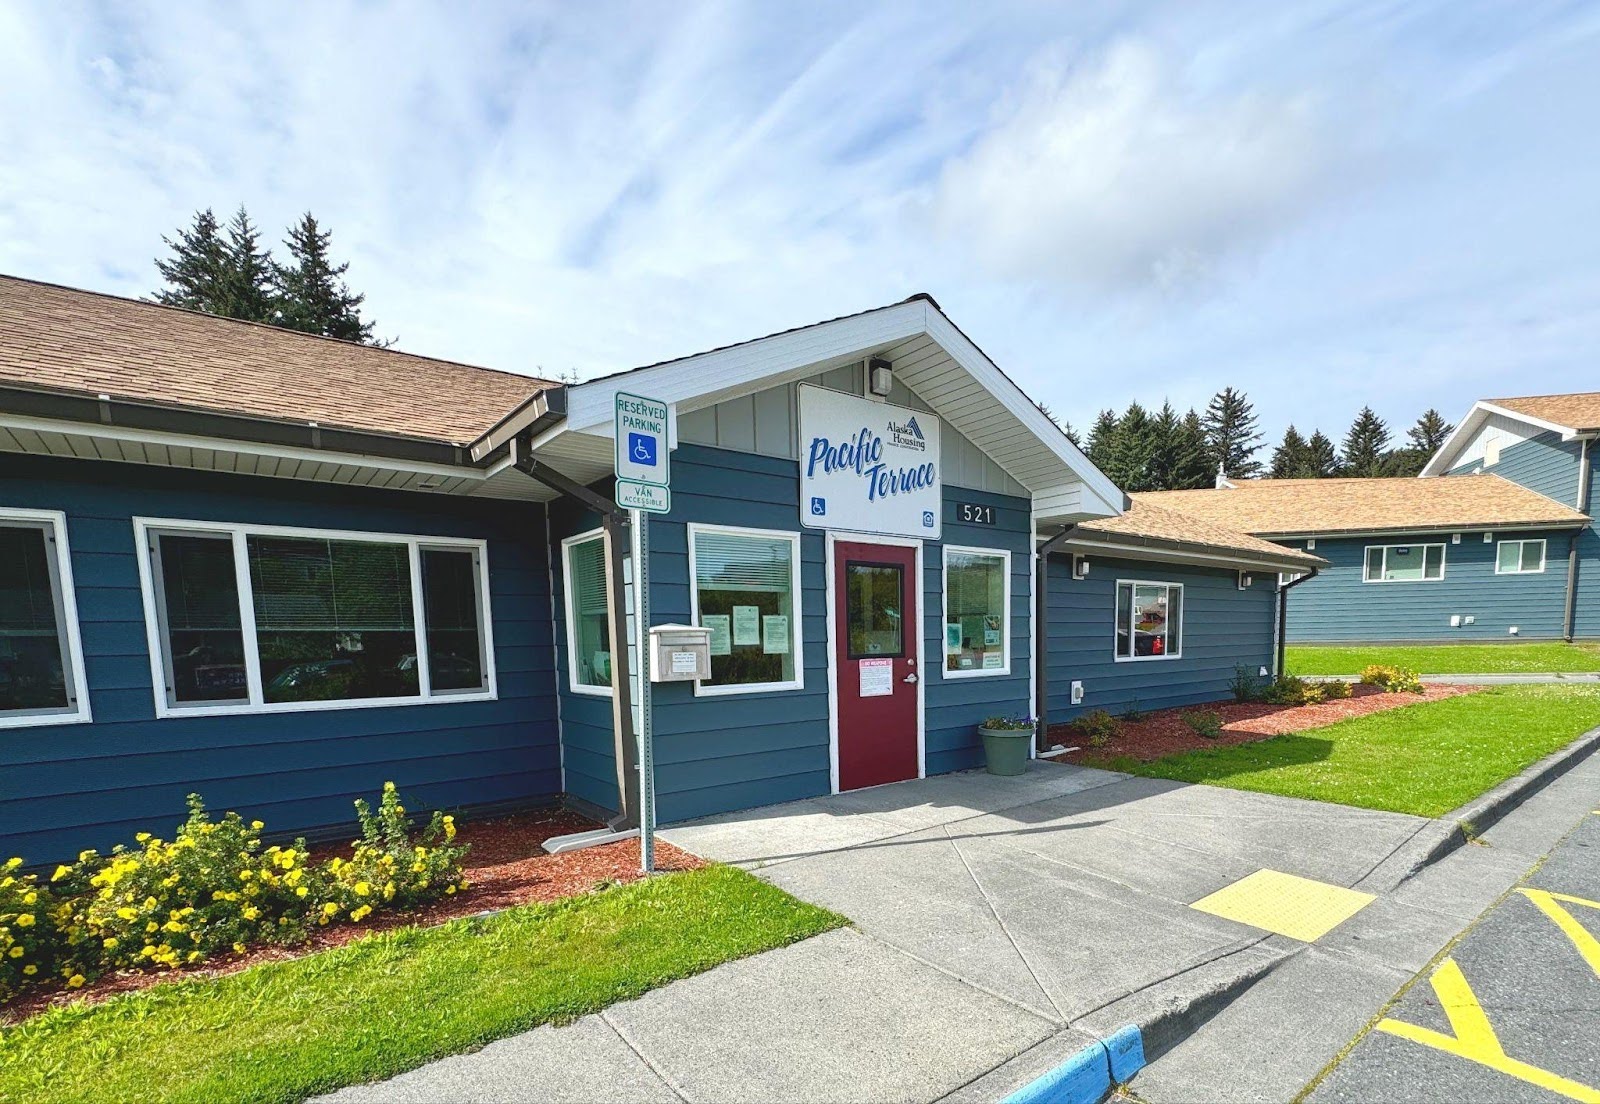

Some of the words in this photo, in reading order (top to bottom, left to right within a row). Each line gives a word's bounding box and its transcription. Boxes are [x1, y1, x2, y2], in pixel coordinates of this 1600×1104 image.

[618, 400, 666, 420] RESERVED
[623, 415, 661, 434] PARKING
[886, 421, 913, 436] Alaska
[893, 432, 925, 452] Housing
[807, 427, 882, 478] Pacific
[863, 462, 935, 502] Terrace
[624, 495, 663, 507] ACCESSIBLE
[635, 487, 652, 498] VAN
[964, 504, 990, 524] 521
